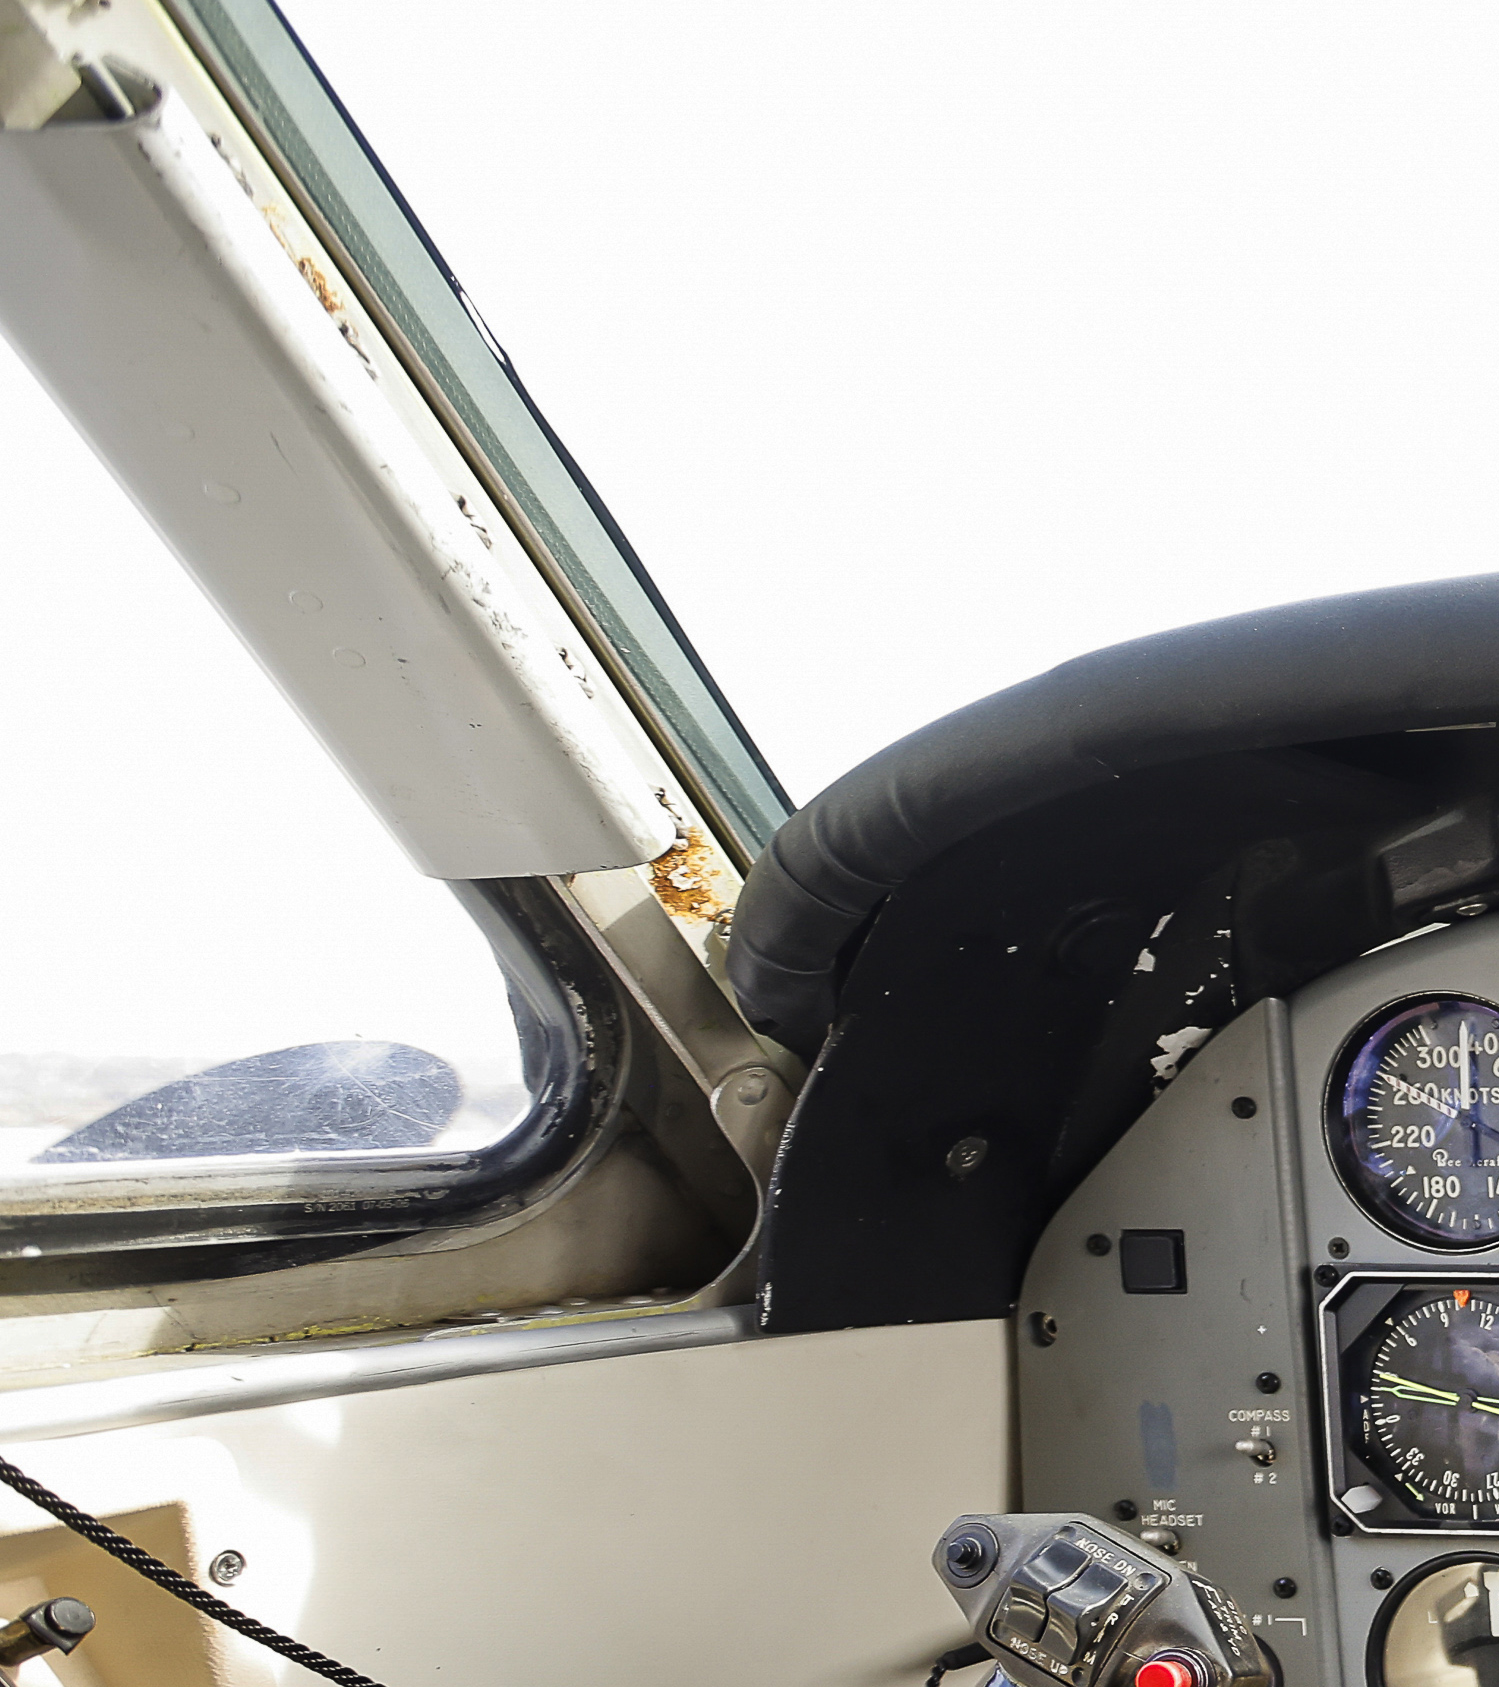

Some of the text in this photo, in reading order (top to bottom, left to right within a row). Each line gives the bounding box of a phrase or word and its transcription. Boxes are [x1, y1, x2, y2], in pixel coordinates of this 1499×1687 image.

[1391, 1126, 1435, 1147] 220
[1228, 1410, 1290, 1422] COMPASS
[1153, 1500, 1177, 1511] MIC
[1141, 1514, 1203, 1527] HEADSET
